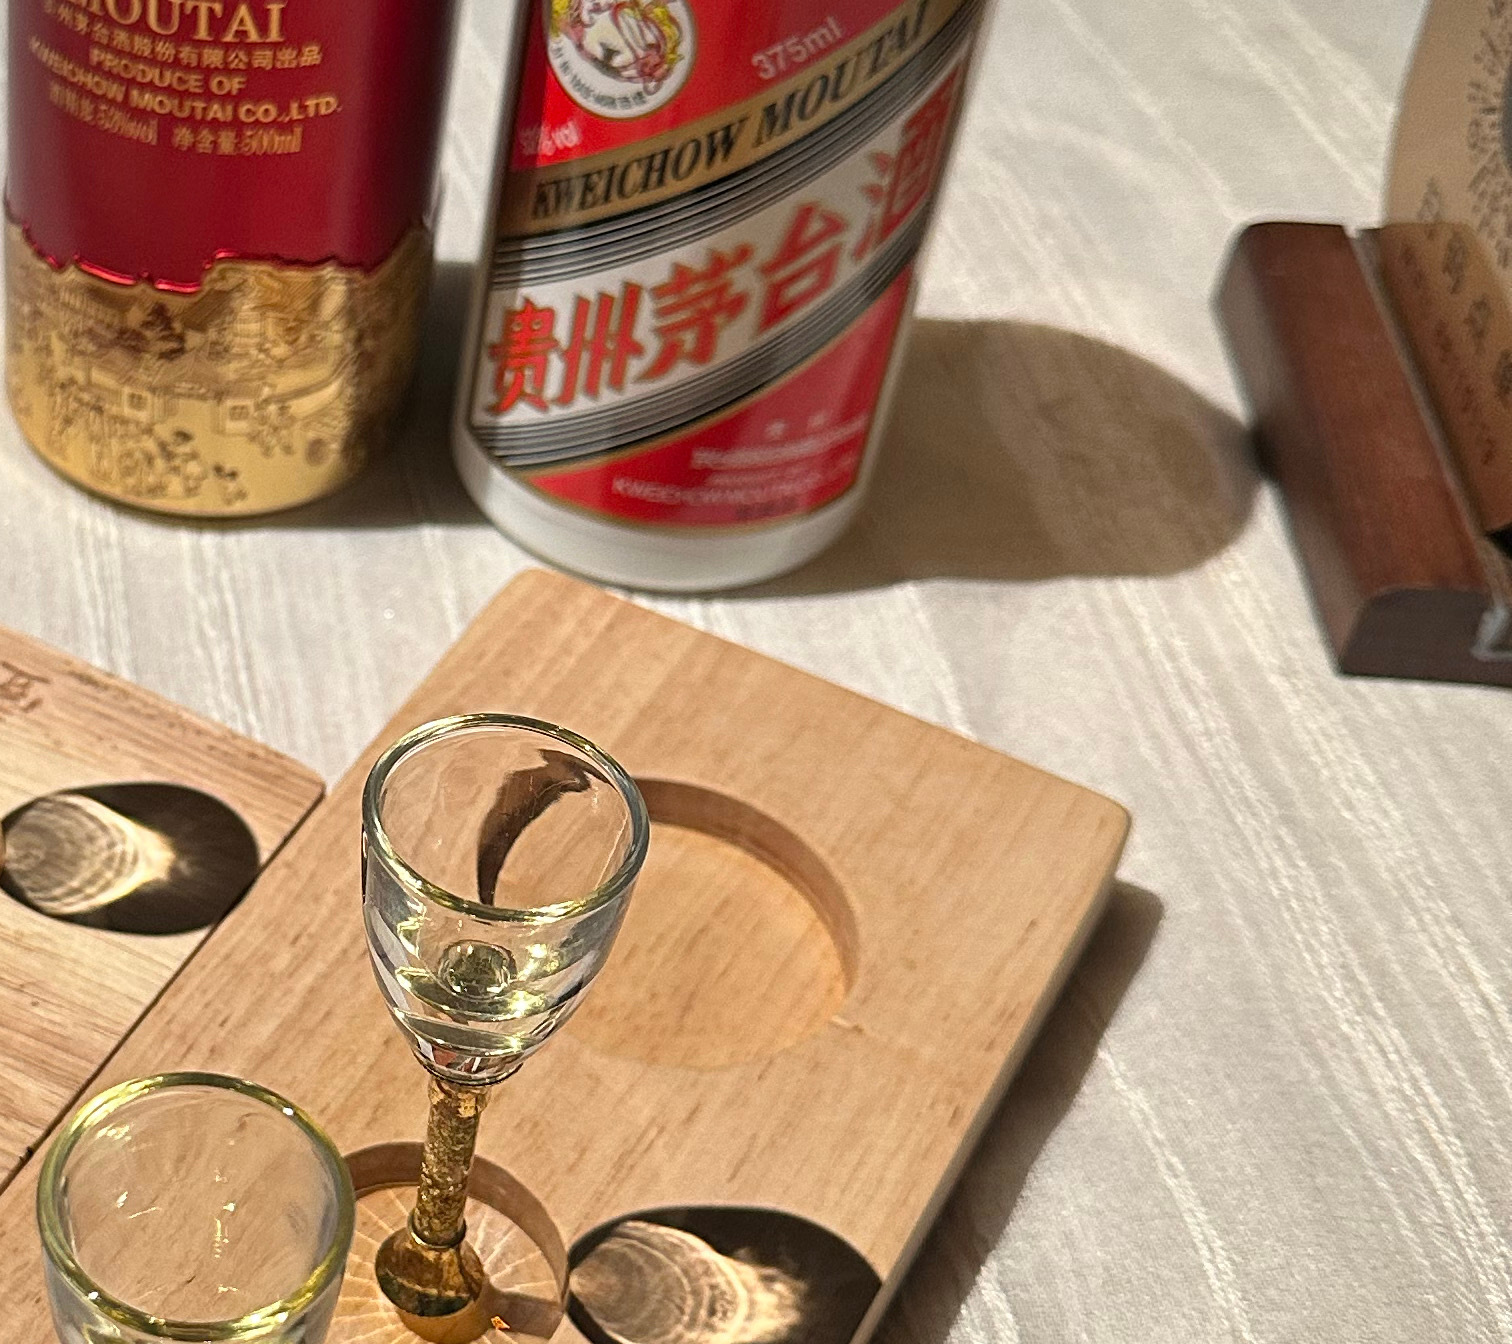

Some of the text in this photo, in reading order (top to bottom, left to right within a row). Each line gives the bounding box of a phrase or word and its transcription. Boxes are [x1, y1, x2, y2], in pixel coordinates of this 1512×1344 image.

[89, 45, 248, 96] PRODUCE OF
[750, 15, 845, 81] 375ml
[128, 86, 234, 123] MOUTAI
[531, 115, 750, 221] KWEICHOW
[486, 64, 962, 418] 贵州茅台酒
